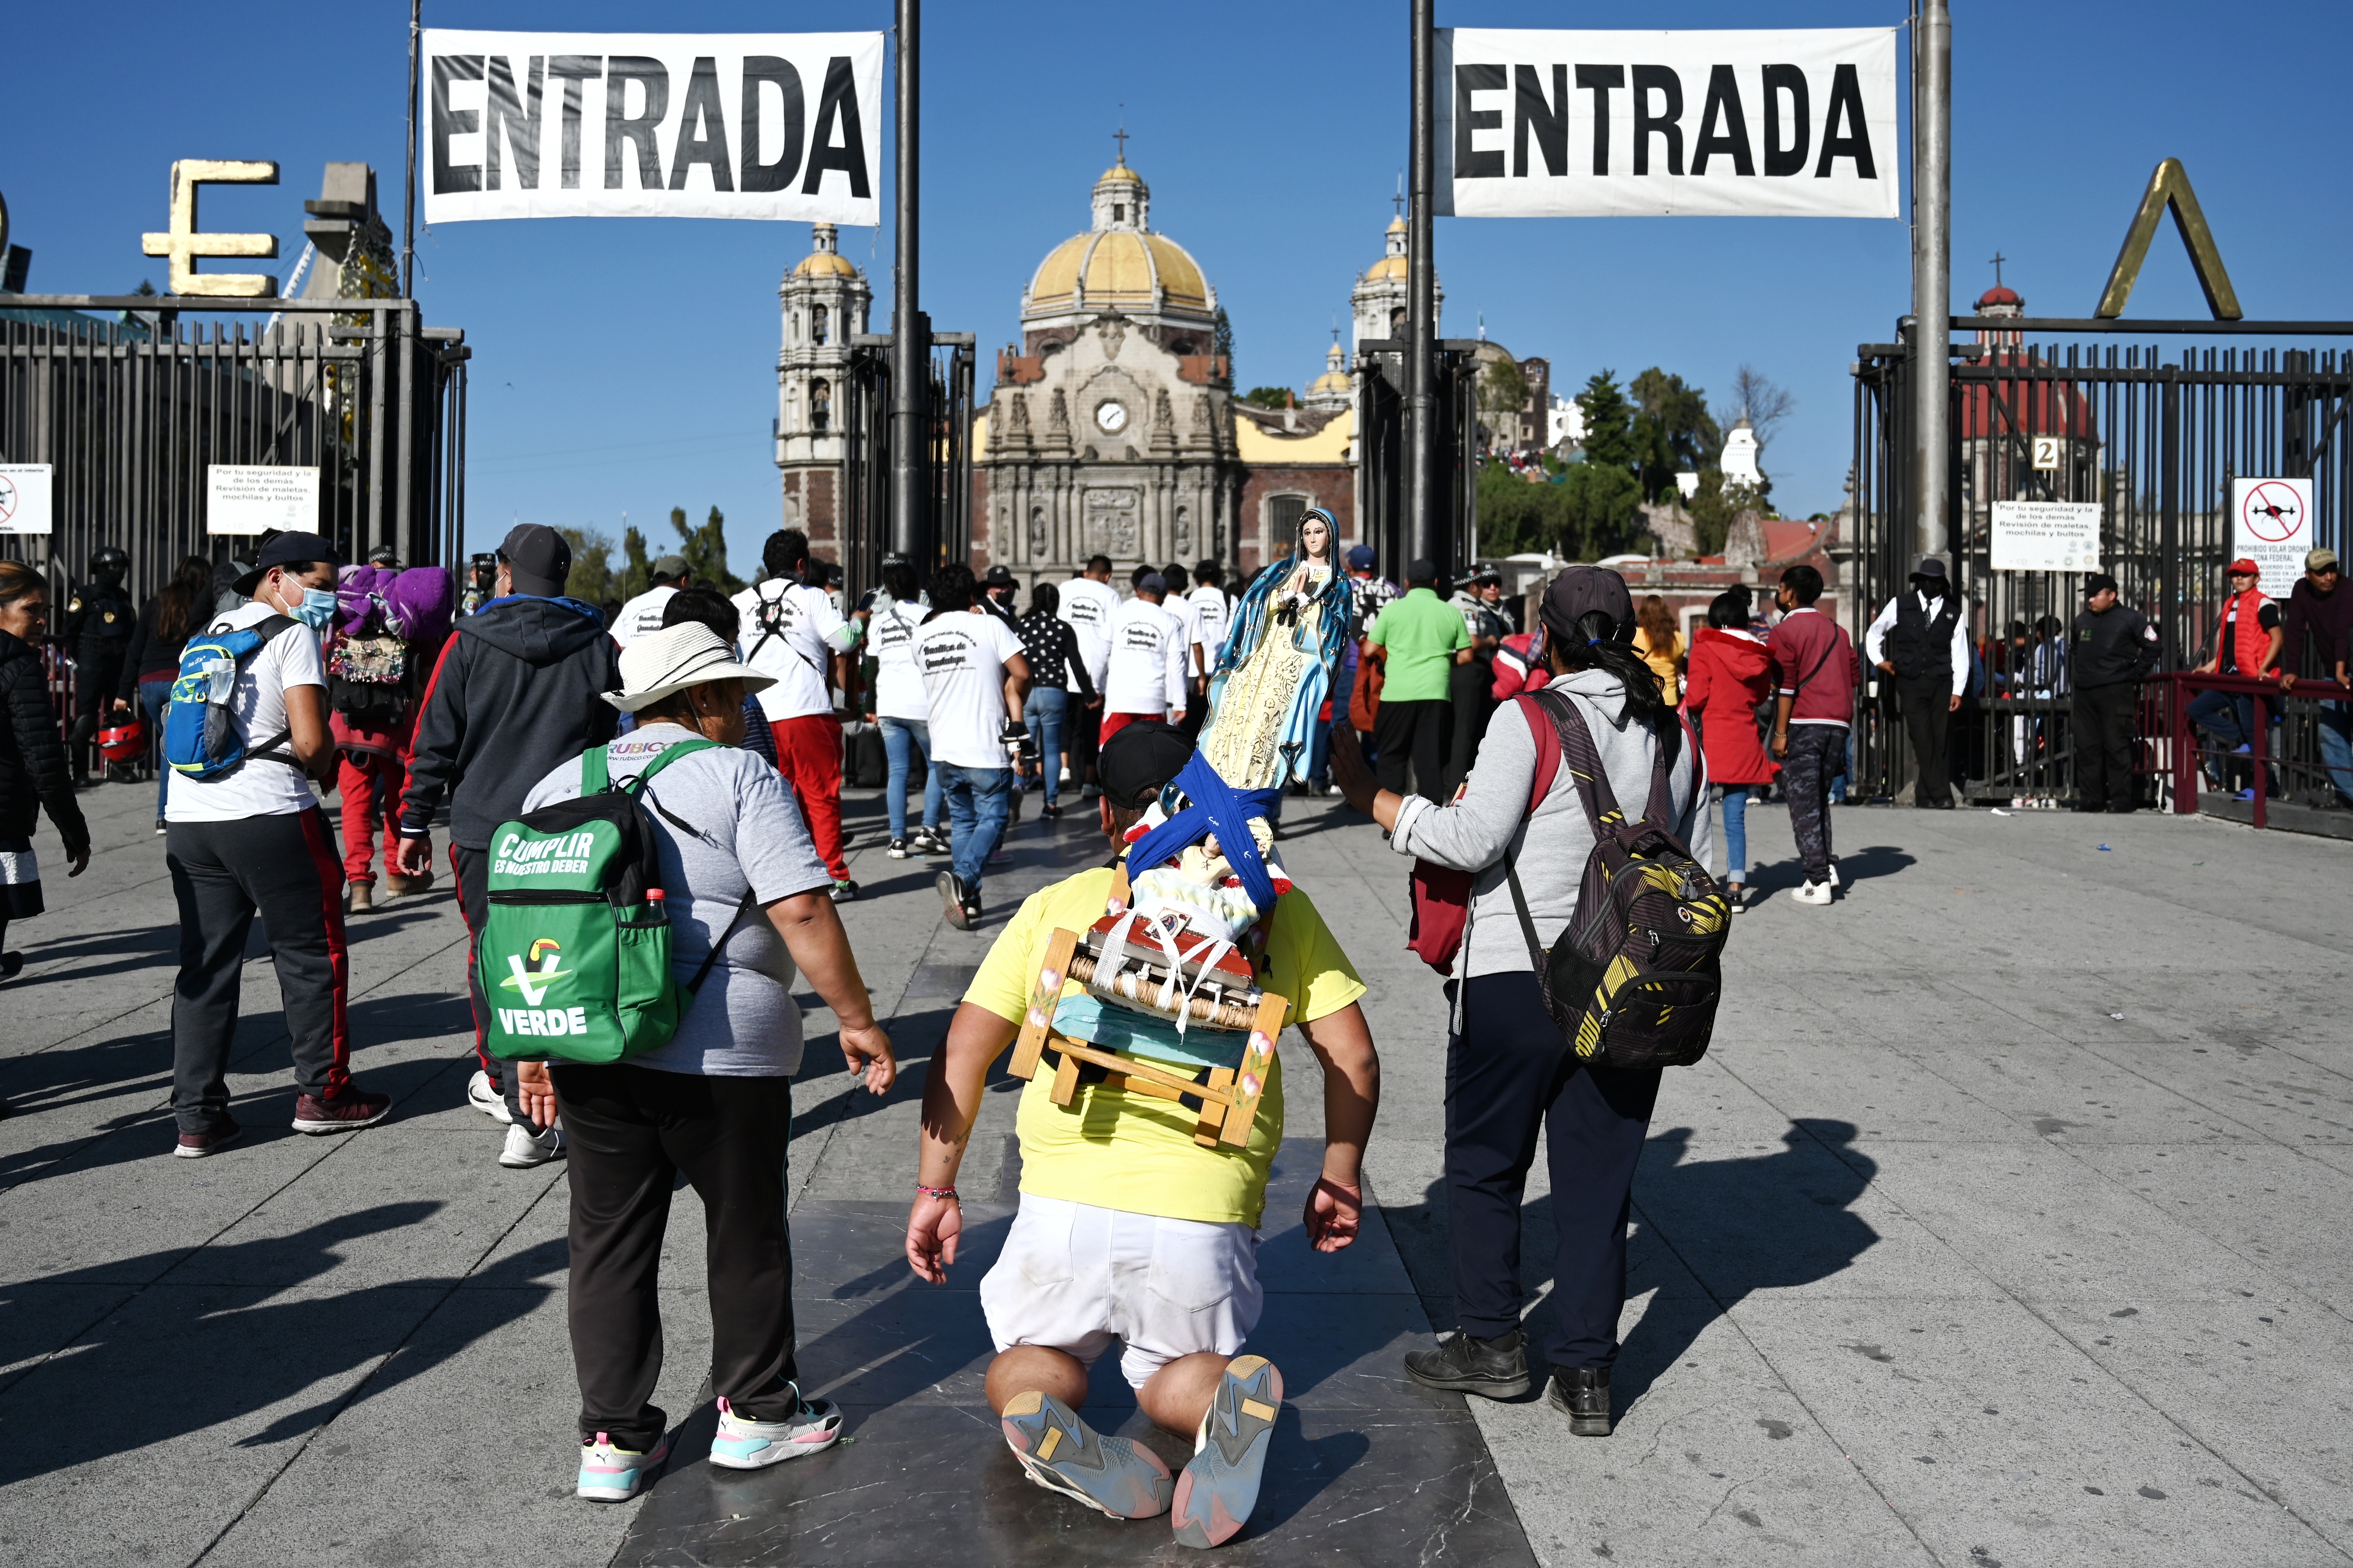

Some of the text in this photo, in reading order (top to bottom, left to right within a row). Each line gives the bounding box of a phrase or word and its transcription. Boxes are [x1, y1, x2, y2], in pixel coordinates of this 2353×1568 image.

[432, 55, 871, 199] ENTRADA
[1454, 63, 1878, 179] ENTRADA
[2038, 442, 2054, 463] 2
[498, 832, 594, 863] CUMPLIR
[494, 860, 588, 876] ES NUESTRO DEBER
[498, 1007, 587, 1037] VERDE
